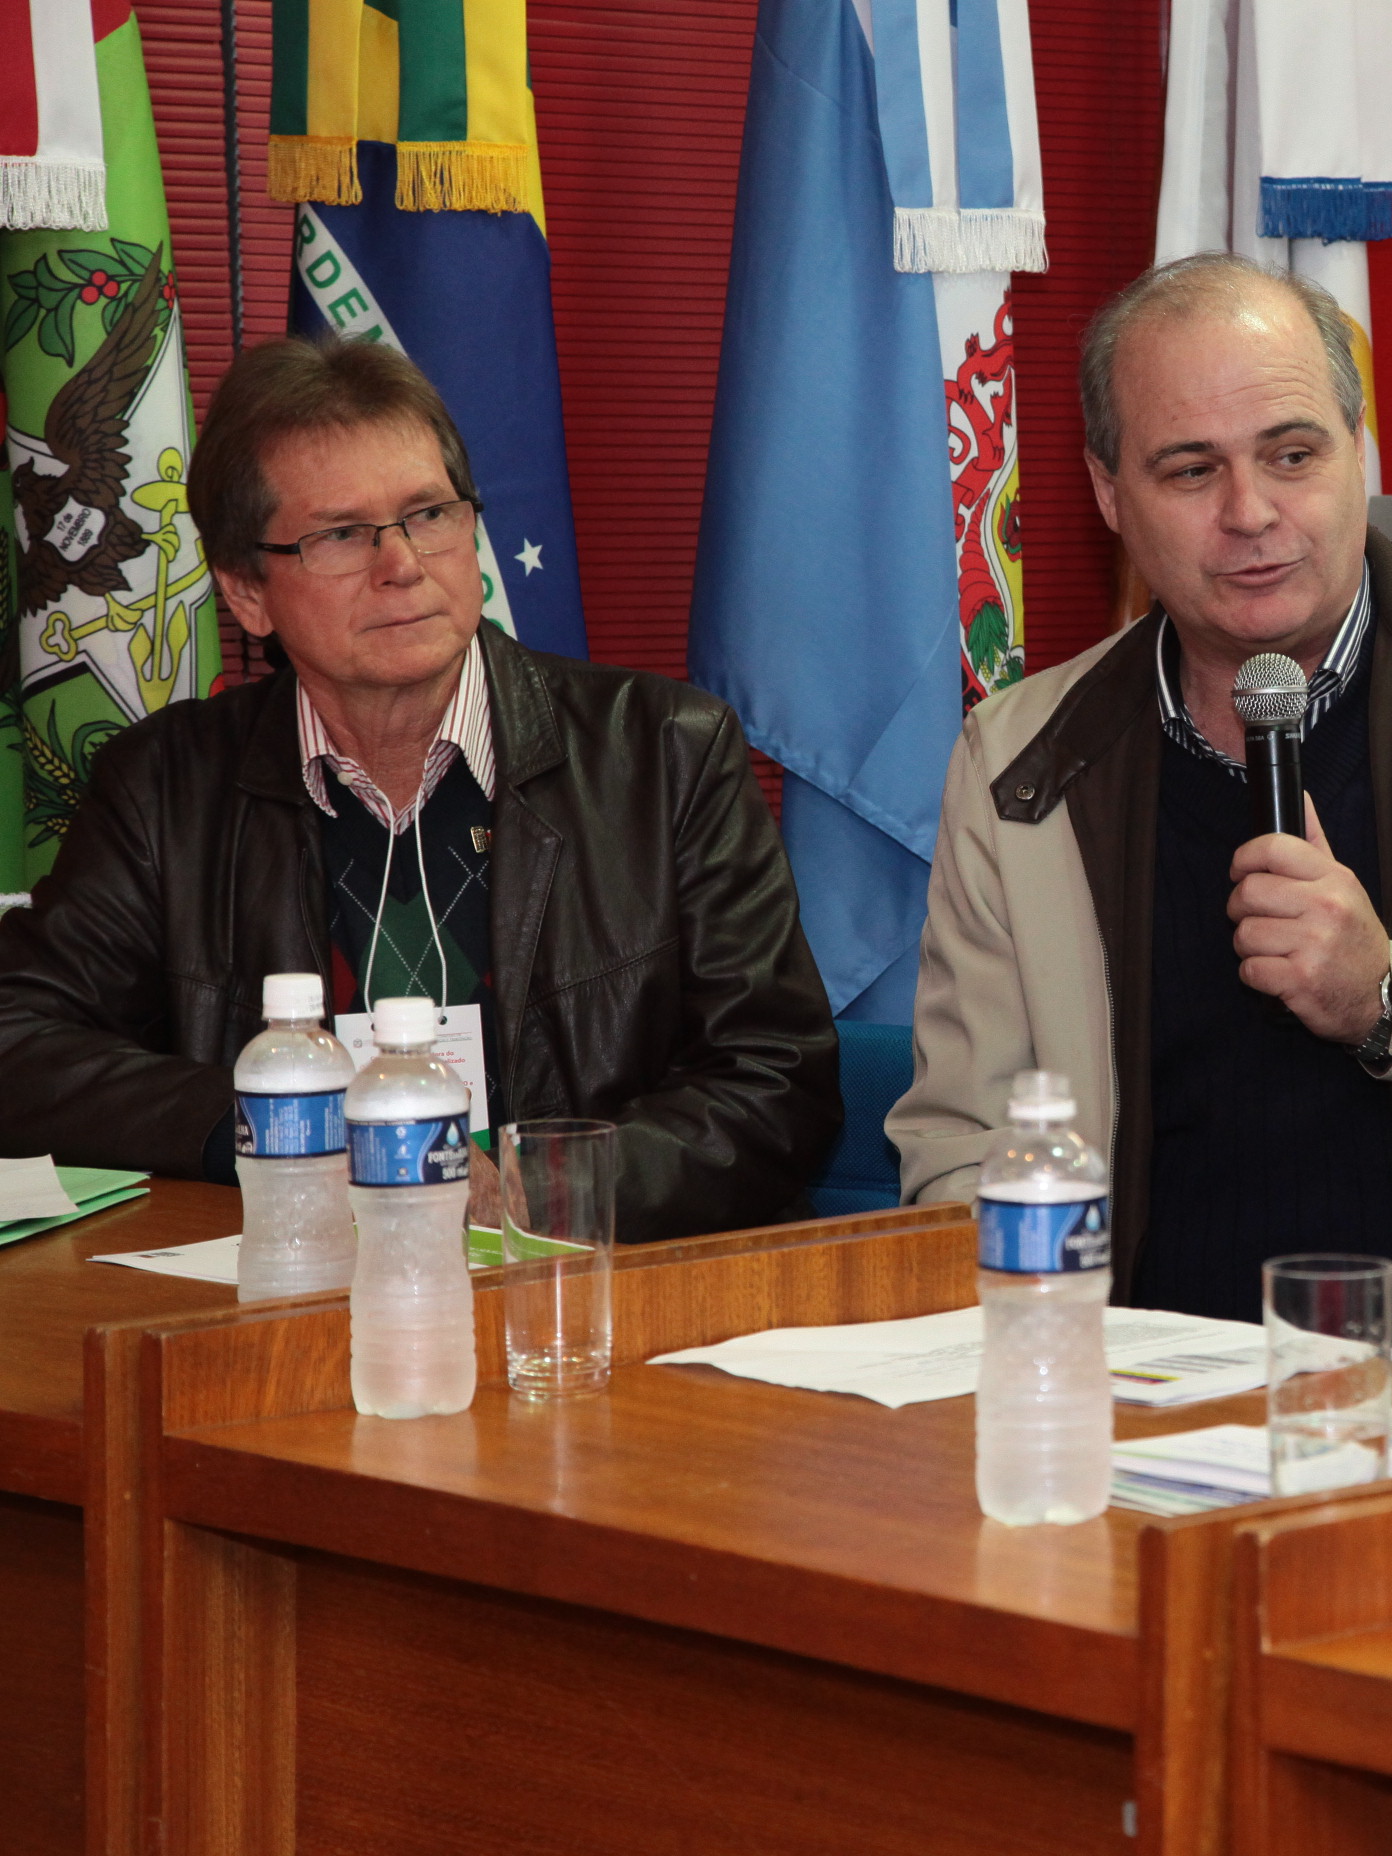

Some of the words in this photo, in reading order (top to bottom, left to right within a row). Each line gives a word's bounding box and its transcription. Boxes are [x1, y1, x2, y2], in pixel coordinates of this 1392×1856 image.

[56, 521, 66, 532] 17
[63, 513, 73, 524] de
[59, 508, 91, 552] NOVEMBRO
